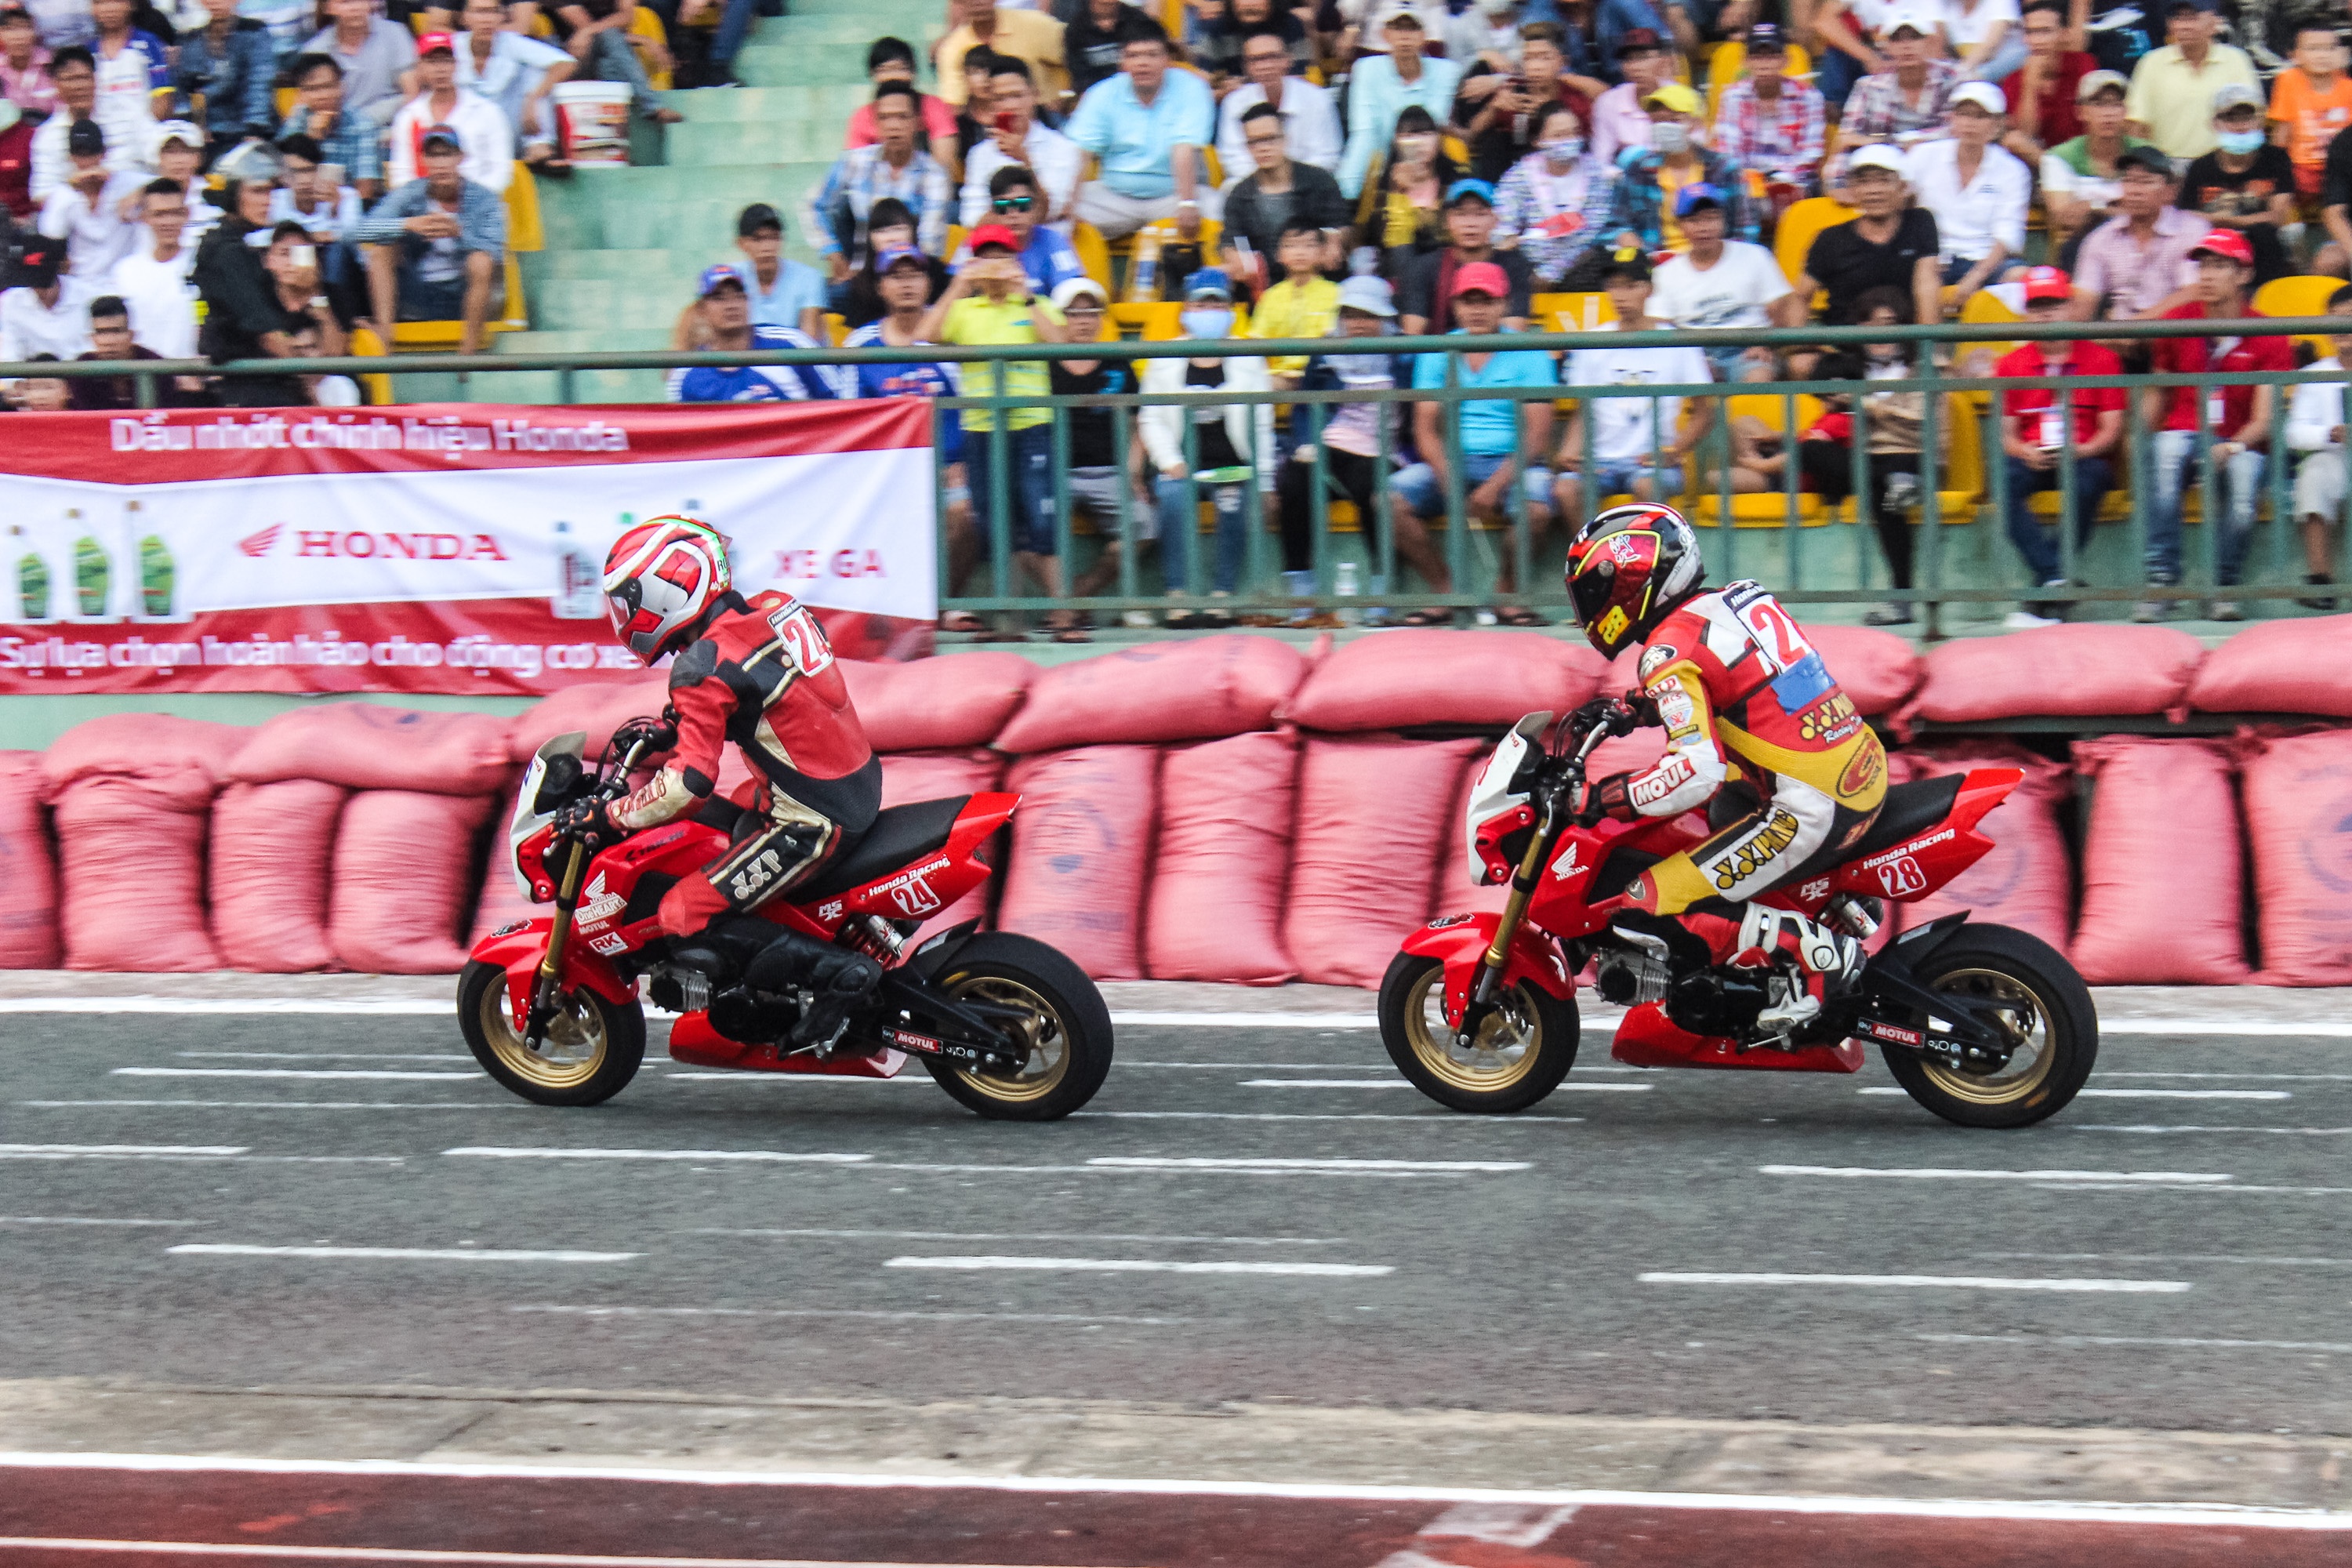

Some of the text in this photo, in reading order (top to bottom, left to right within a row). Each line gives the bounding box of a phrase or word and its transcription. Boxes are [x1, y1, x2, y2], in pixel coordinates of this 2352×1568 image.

[492, 418, 630, 452] Honda
[295, 530, 513, 561] HONDA
[771, 549, 890, 579] XE GA
[370, 634, 444, 667] cho
[1635, 760, 1692, 806] MOUL
[1862, 827, 1956, 870] Honda Racing
[868, 855, 952, 897] Honda Racing
[1555, 864, 1590, 882] HONDA
[1881, 858, 1925, 896] 28
[589, 891, 618, 906] HONDA
[893, 879, 938, 914] 24
[579, 920, 610, 935] MOTUL
[592, 933, 621, 951] RK
[897, 1033, 935, 1051] MOTUL
[1875, 1025, 1917, 1044] MOTUL
